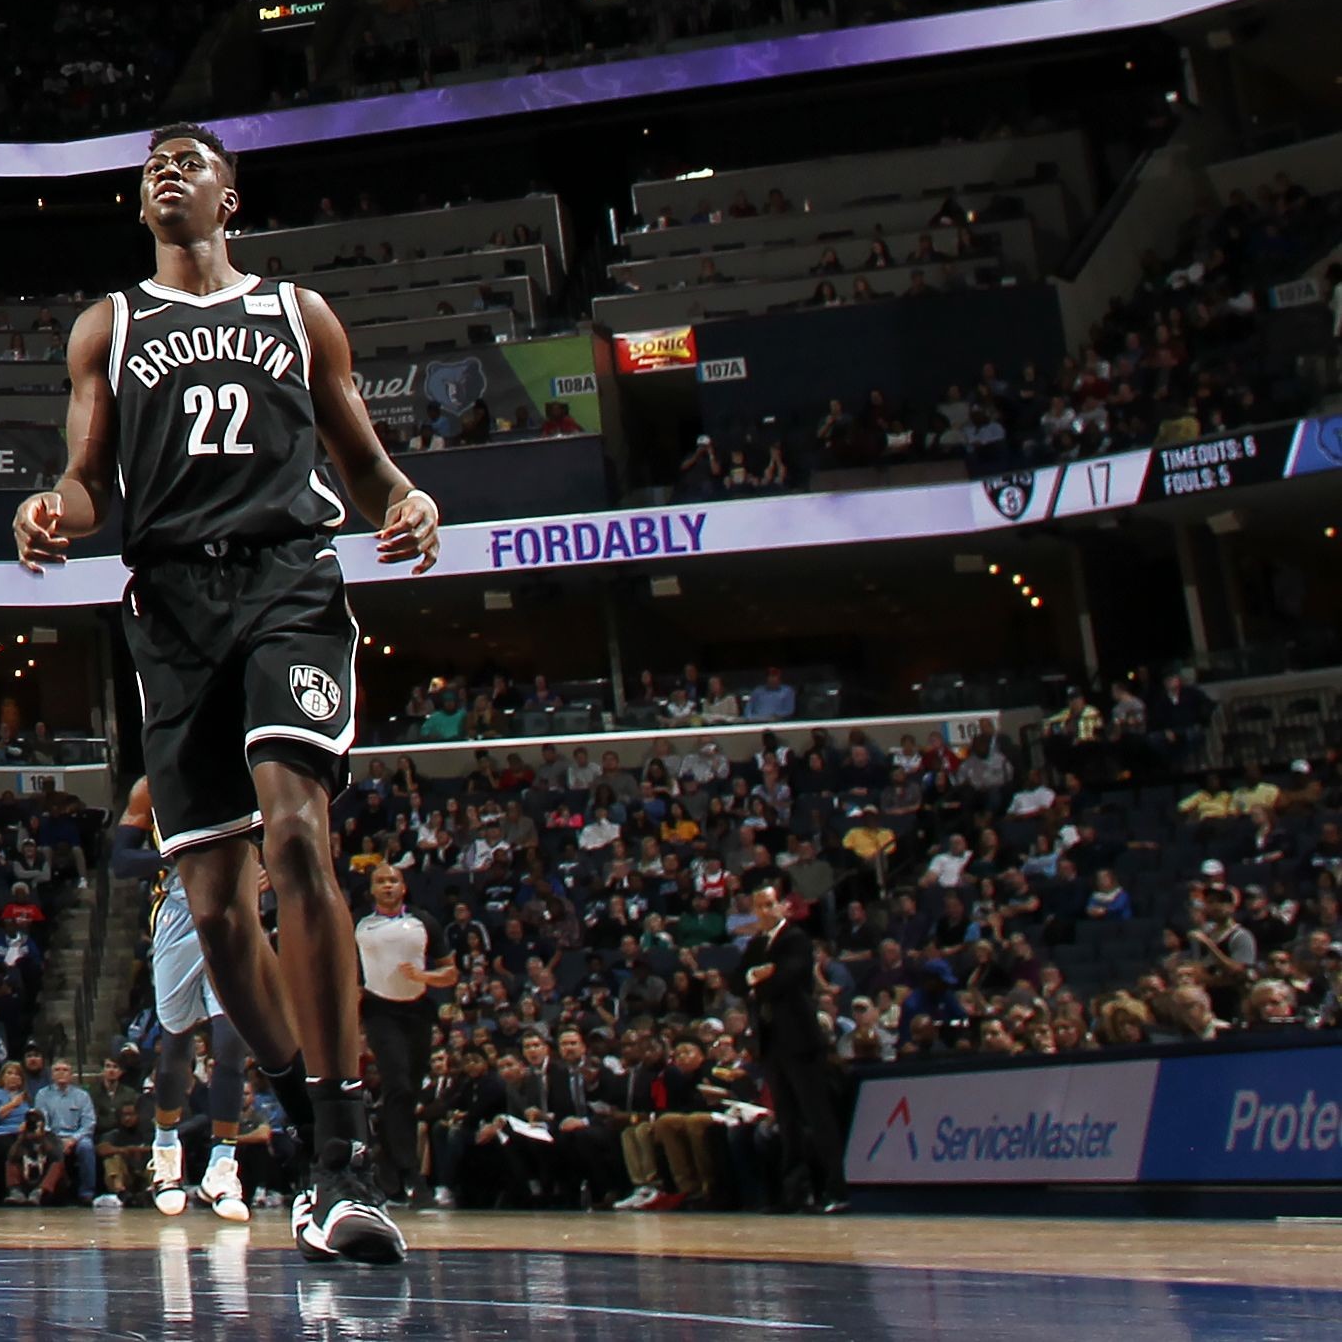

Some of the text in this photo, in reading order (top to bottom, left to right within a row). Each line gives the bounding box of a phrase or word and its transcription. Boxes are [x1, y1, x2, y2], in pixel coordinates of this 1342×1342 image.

[127, 325, 294, 389] BROOKLYN
[632, 337, 687, 356] SONIC
[556, 376, 595, 395] 108A
[705, 360, 742, 379] 107A
[183, 383, 254, 456] 22
[1161, 438, 1242, 473] TIMEOUTS:
[1087, 461, 1110, 506] 17
[1164, 469, 1217, 496] FOULS:
[490, 513, 707, 568] FORDABLY
[293, 668, 341, 705] NETS
[930, 1111, 1117, 1162] ServiceMaster
